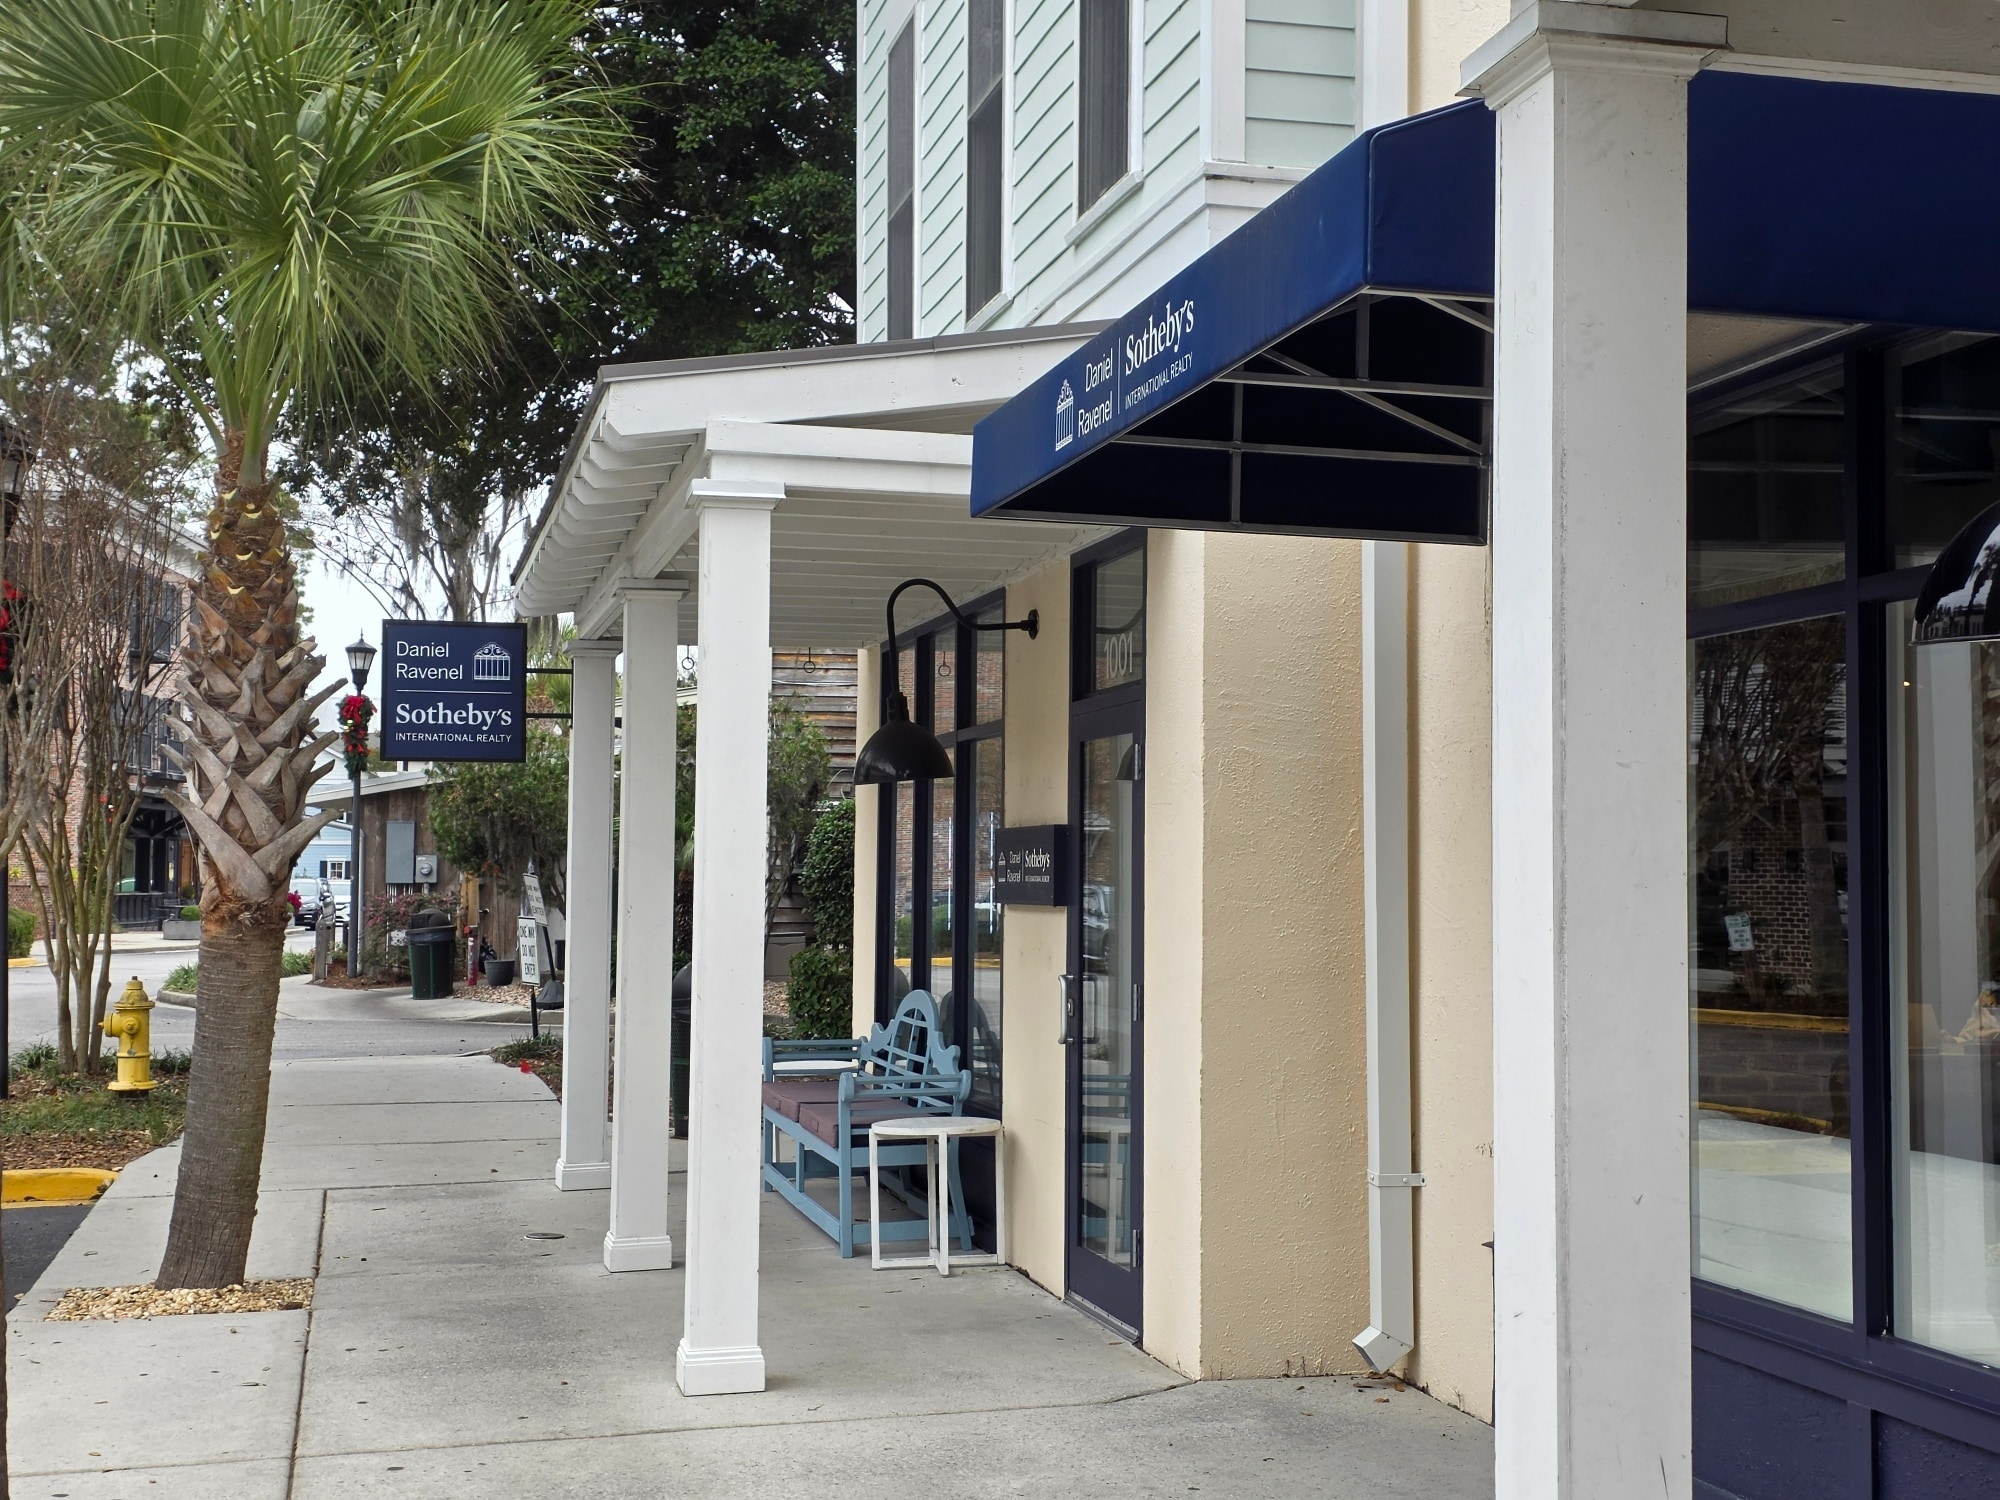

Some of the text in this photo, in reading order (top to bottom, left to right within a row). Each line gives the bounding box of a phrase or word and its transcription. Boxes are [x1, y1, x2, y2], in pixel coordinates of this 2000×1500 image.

[1125, 299, 1194, 377] Sotheby's
[1085, 347, 1113, 393] Daniel
[1125, 351, 1193, 410] INTERNATIONAL REALTY
[1077, 390, 1113, 438] Ravenel
[396, 640, 449, 657] Daniel
[1104, 631, 1133, 679] 1001
[396, 663, 463, 680] Ravenel
[395, 701, 512, 731] Sotheby's
[395, 732, 512, 743] INTERNATIONAL REALTY
[1010, 851, 1020, 863] Daniel
[1025, 848, 1050, 872] Sotheby's
[1007, 869, 1020, 882] Ravenel
